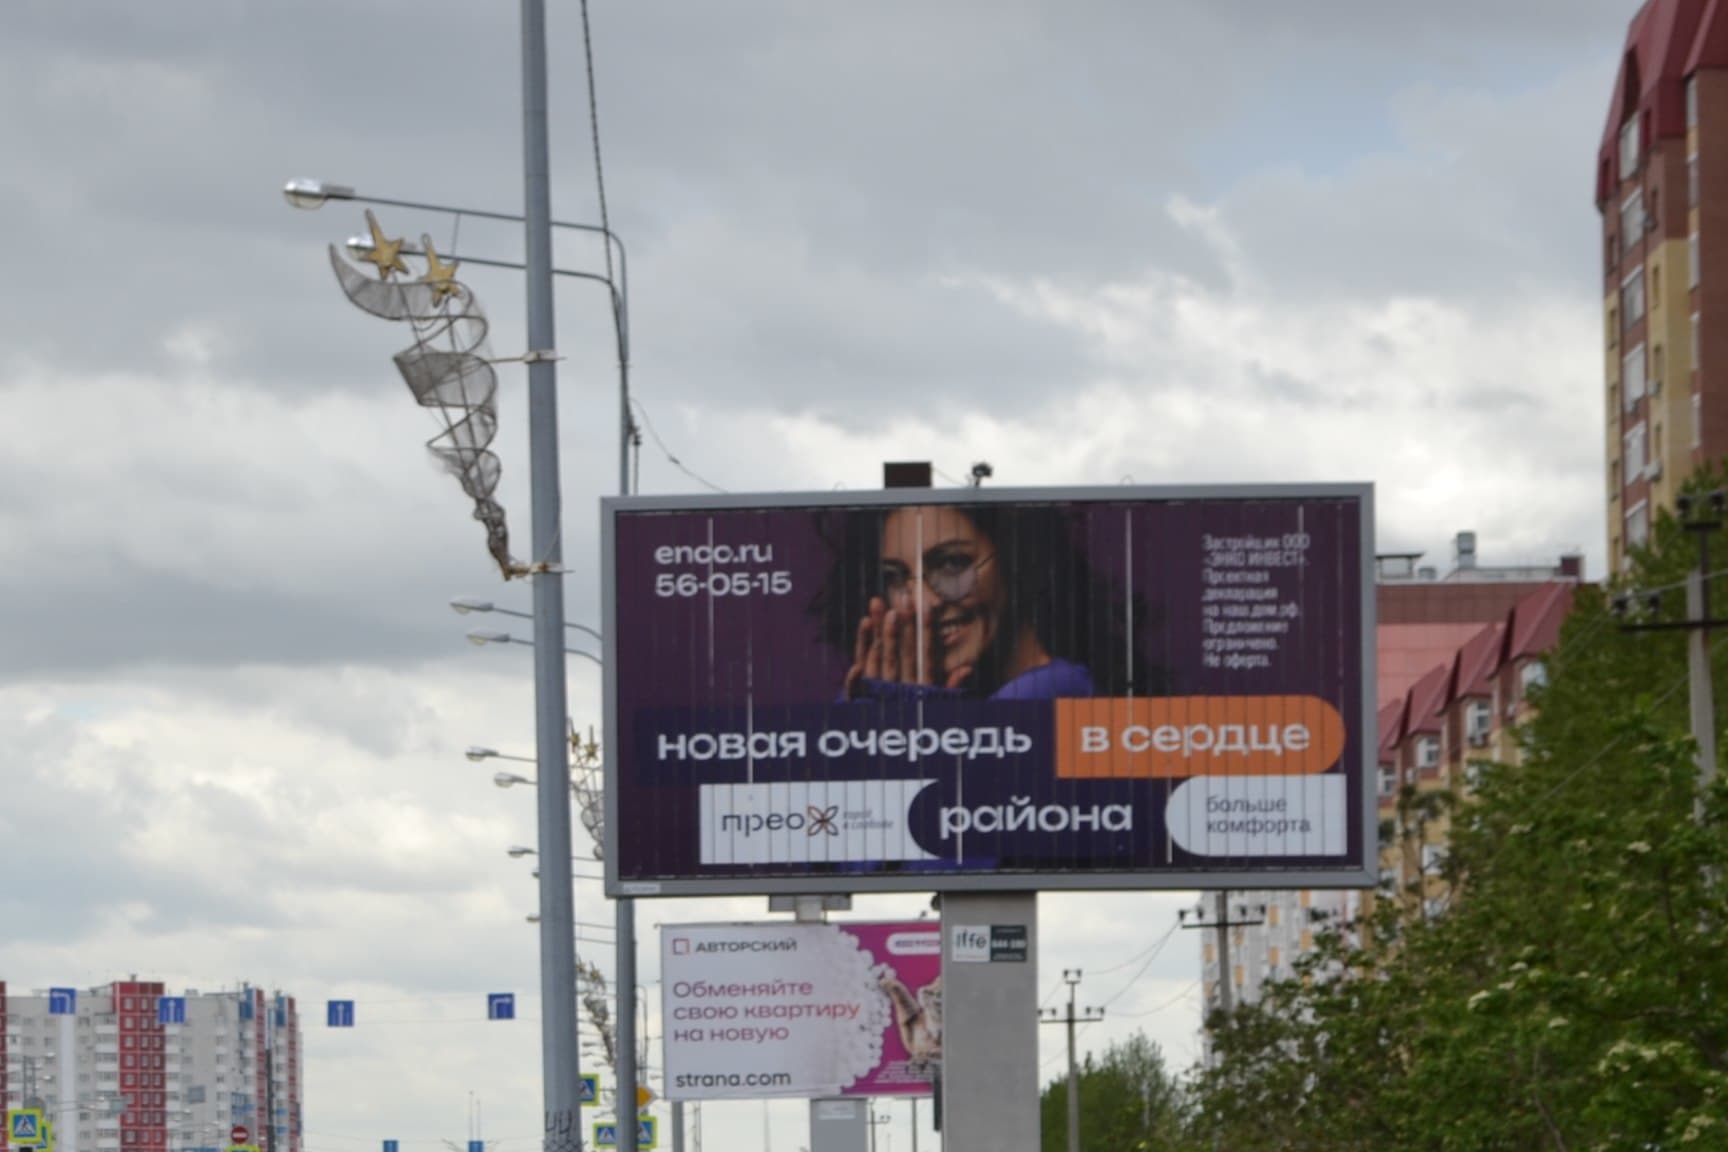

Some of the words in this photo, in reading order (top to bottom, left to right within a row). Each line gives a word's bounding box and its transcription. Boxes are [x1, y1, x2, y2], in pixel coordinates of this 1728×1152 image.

[654, 543, 773, 565] enco.ru
[655, 571, 792, 597] 56-05-15
[657, 731, 807, 760] новая
[817, 726, 1033, 762] очередь
[1080, 726, 1110, 753] в
[1120, 722, 1312, 758] сердце
[1205, 796, 1288, 814] больше
[939, 795, 1133, 840] района
[1205, 815, 1312, 836] комфорта
[695, 937, 798, 953] АВТОРСКИЙ
[673, 979, 813, 999] Обменяйте
[673, 1005, 738, 1021] свою
[744, 1002, 860, 1021] квартиру
[673, 1028, 704, 1043] на
[710, 1025, 790, 1043] новую
[676, 1072, 792, 1089] strana.com
